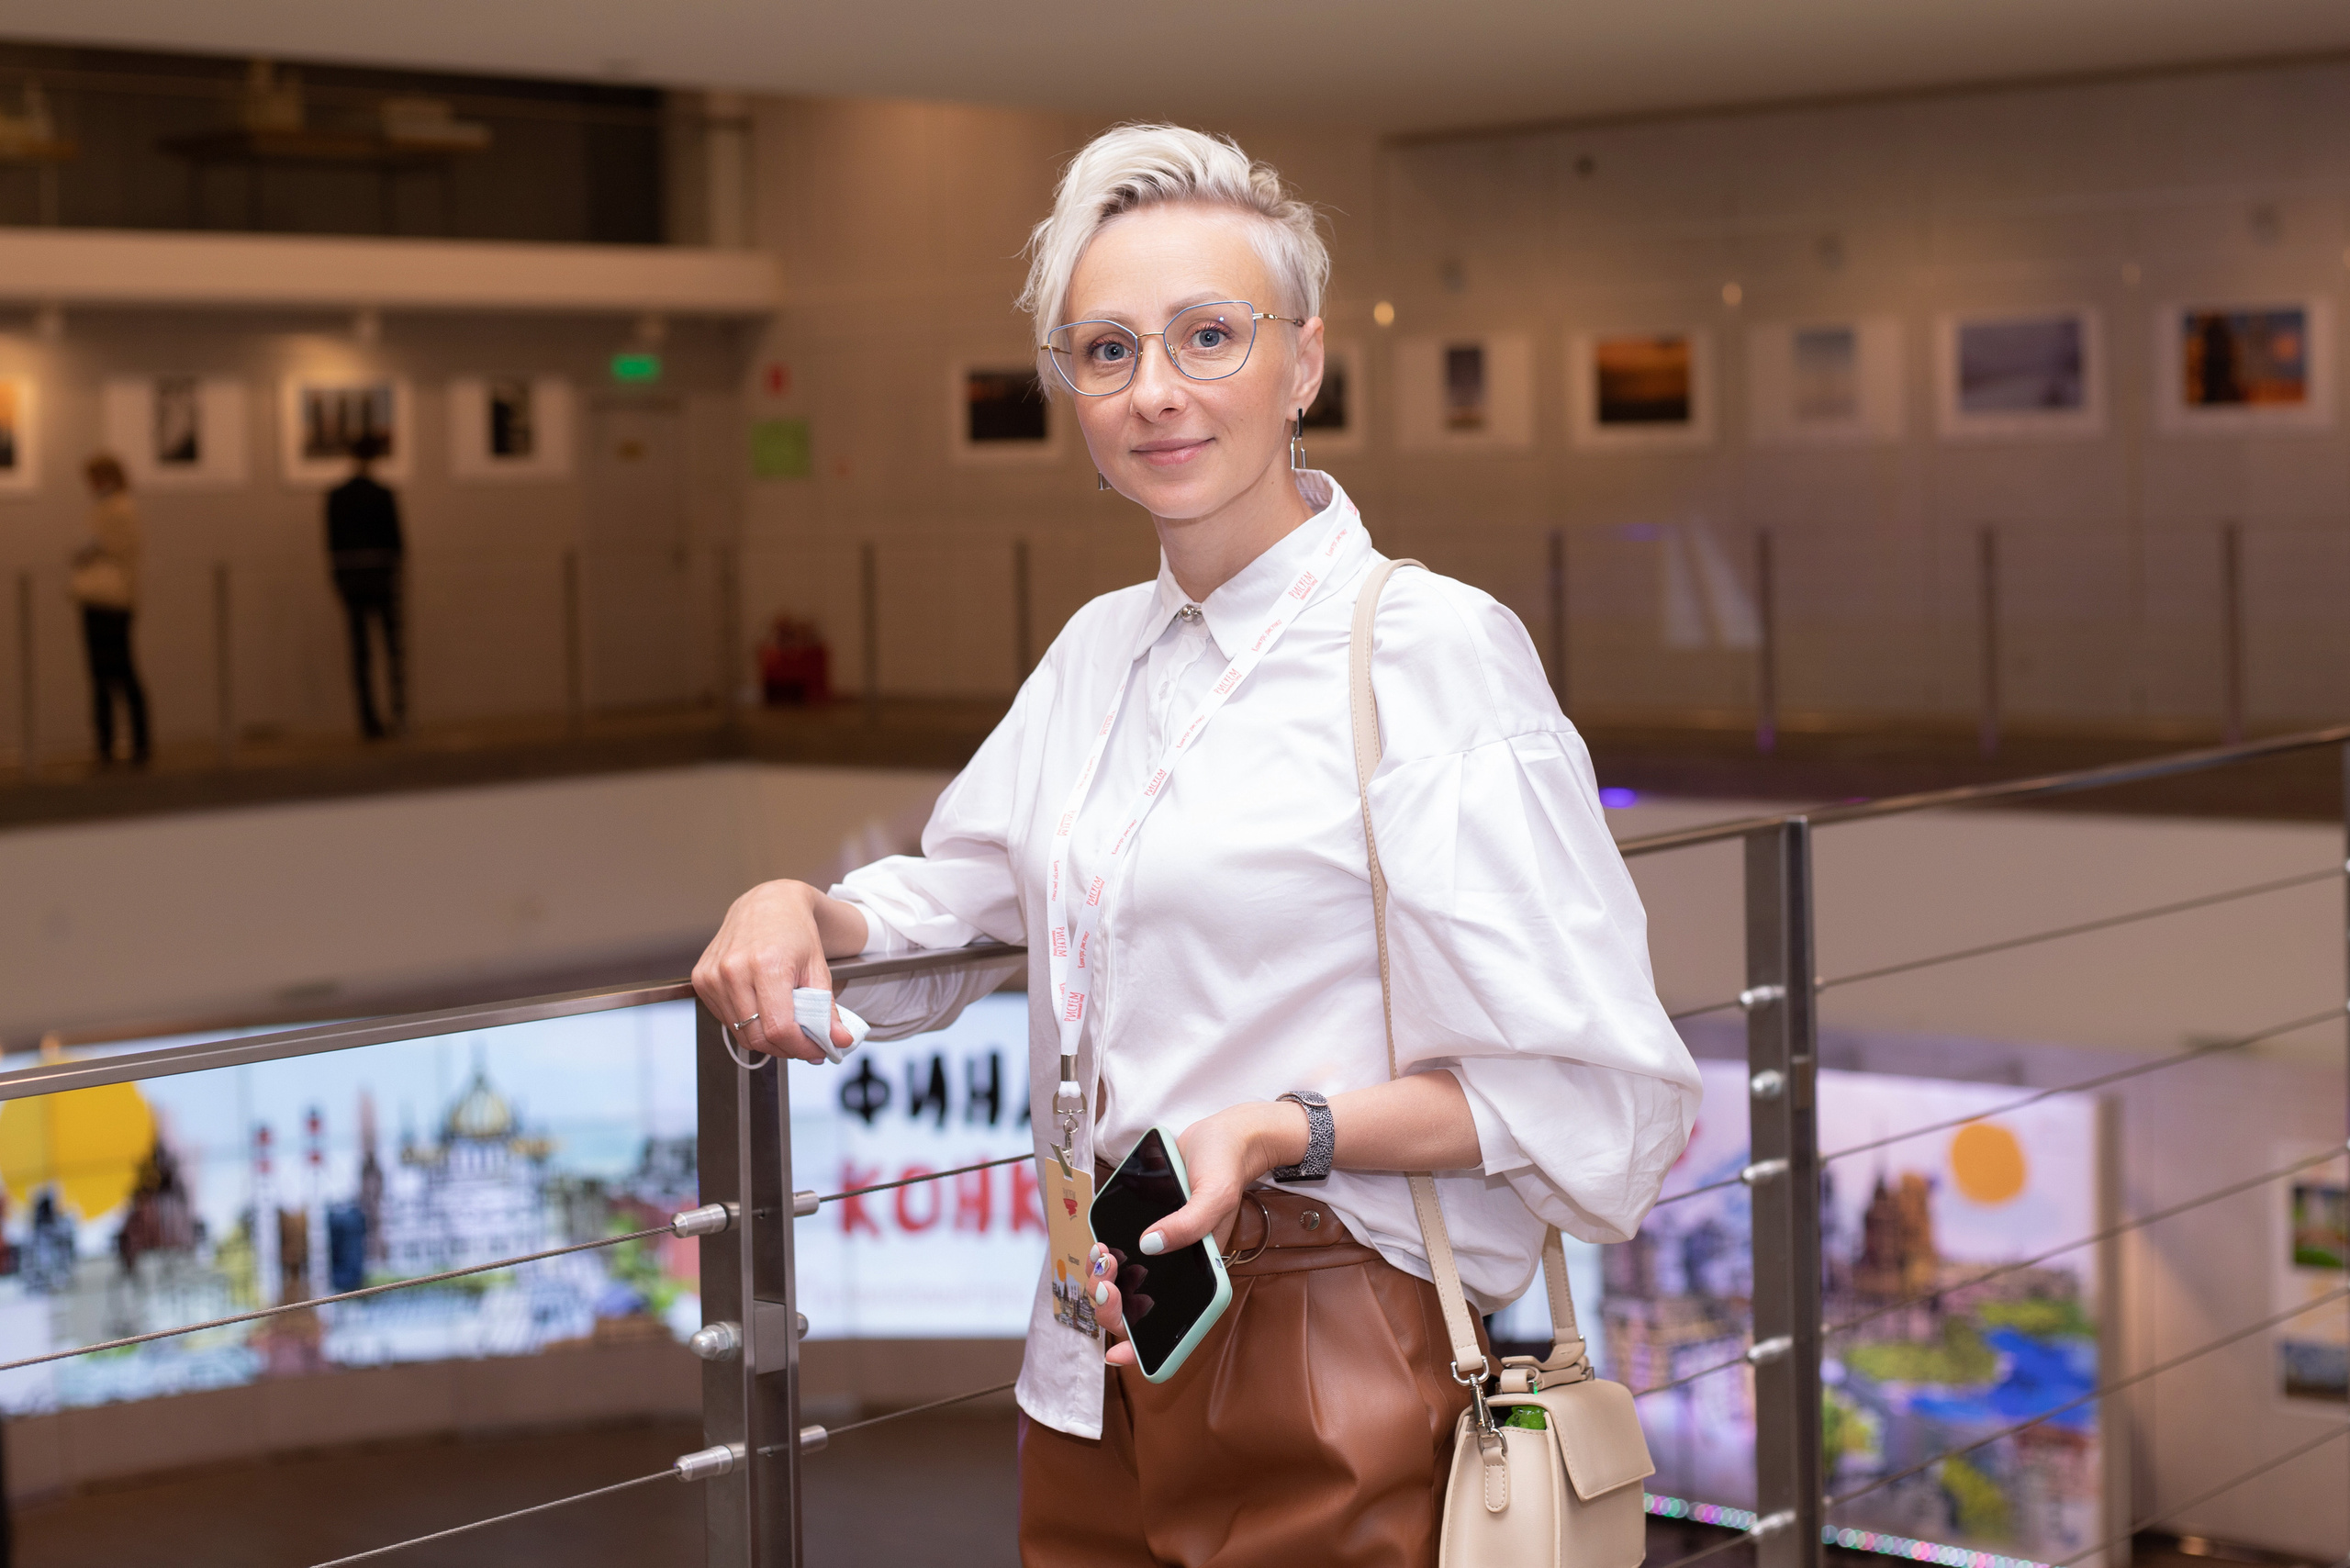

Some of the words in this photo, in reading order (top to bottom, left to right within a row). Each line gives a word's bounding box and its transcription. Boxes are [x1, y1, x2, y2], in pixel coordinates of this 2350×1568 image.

[1288, 571, 1315, 599] РИСУЕМ
[1214, 668, 1240, 695] РИСУЕМ
[1144, 768, 1165, 796] РИСУЕМ
[1086, 876, 1102, 907] РИСУЕМ
[1056, 926, 1068, 958] РИСУЕМ
[1064, 991, 1081, 1022] РИСУЕМ
[839, 1051, 1031, 1128] ФИН
